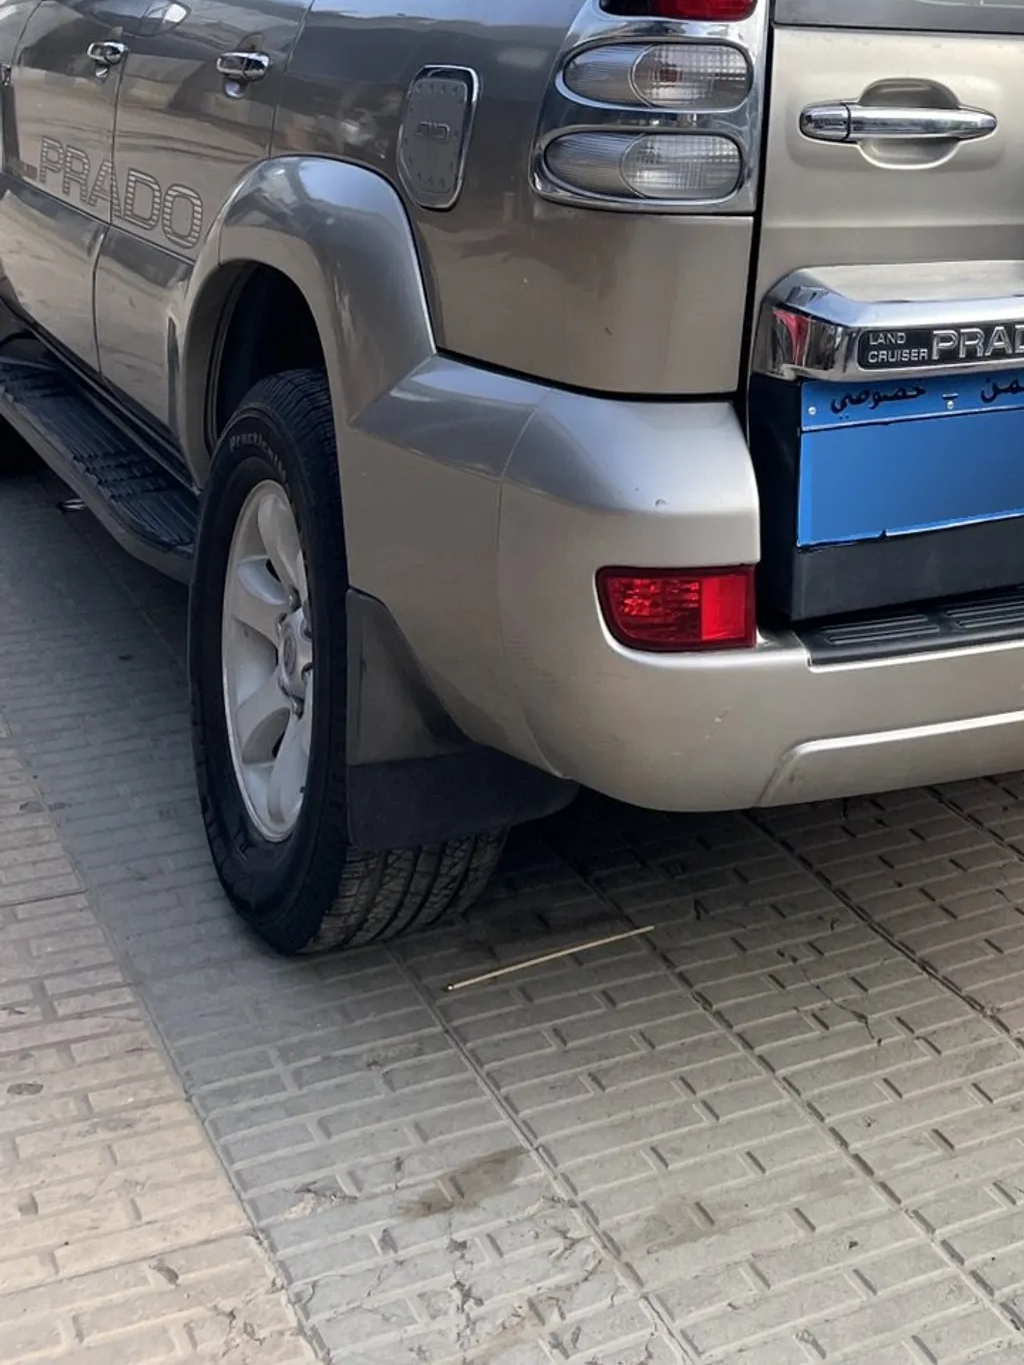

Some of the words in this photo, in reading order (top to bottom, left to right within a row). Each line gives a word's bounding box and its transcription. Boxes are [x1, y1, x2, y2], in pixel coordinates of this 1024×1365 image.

[39, 136, 203, 250] PRADO
[868, 332, 906, 346] LAND
[867, 347, 928, 364] CRUISER
[830, 378, 928, 421] خصوصي
